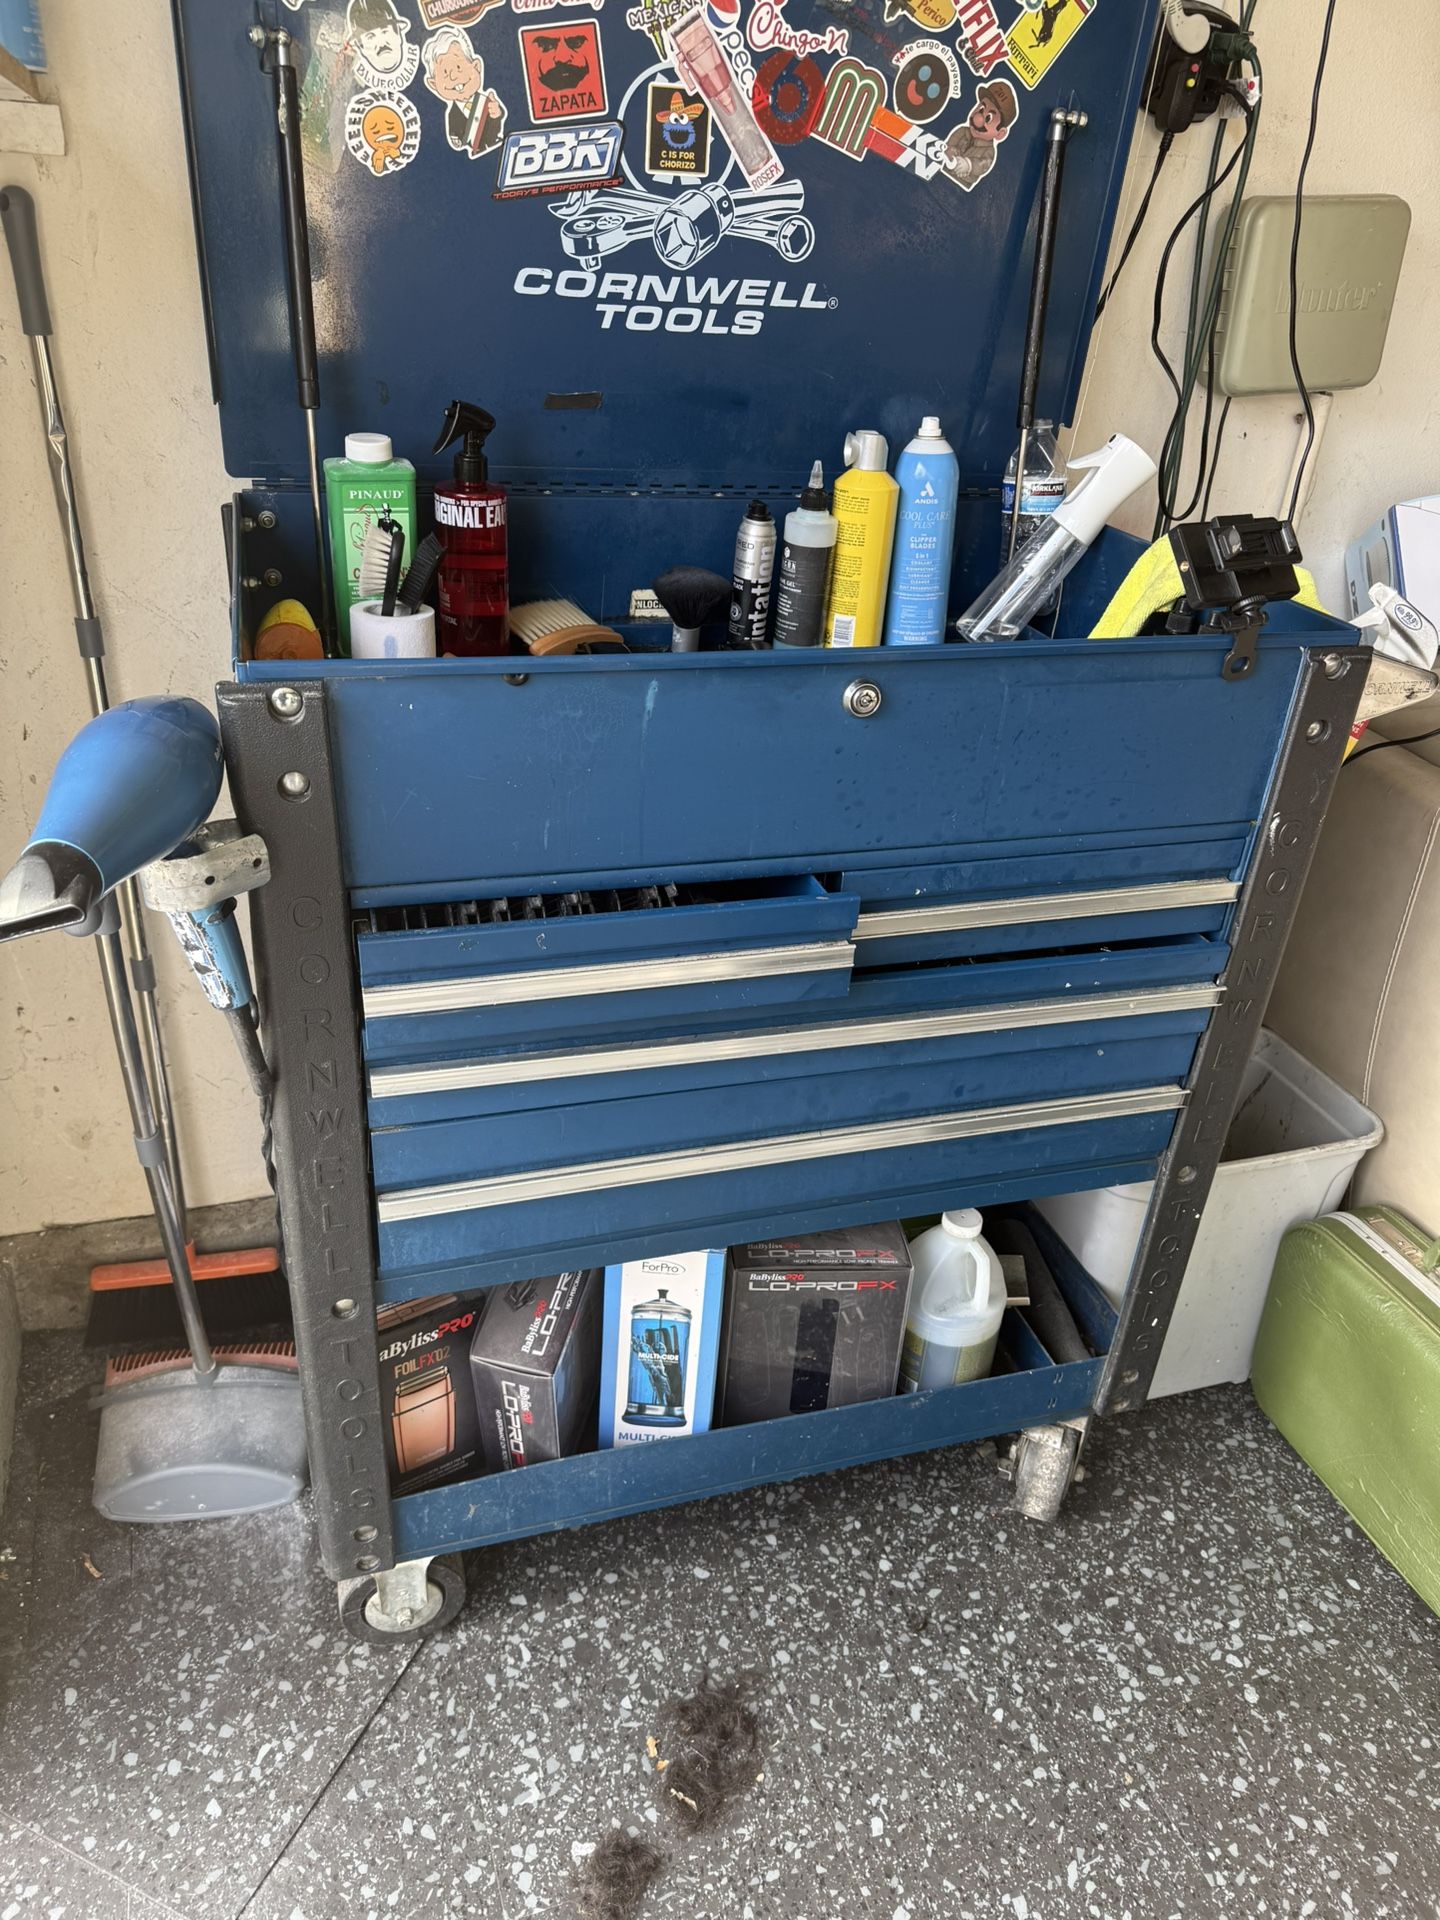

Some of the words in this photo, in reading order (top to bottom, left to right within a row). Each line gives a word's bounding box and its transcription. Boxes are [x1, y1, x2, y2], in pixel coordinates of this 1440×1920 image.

[915, 41, 935, 50] cargo
[941, 47, 949, 56] el
[540, 91, 597, 113] ZAPATA
[514, 128, 612, 176] BBK
[661, 151, 667, 159] C
[669, 151, 677, 159] IS
[679, 151, 695, 160] FOR
[659, 160, 696, 169] CHORIZO
[751, 162, 782, 190] ROSEFX
[513, 267, 828, 309] CORNWELL
[596, 304, 765, 335] TOOLS
[349, 490, 402, 499] PINAUD
[641, 1261, 679, 1274] ForPro
[750, 1273, 805, 1282] BaBylissPRO
[749, 1280, 897, 1292] LO-PROFX
[637, 1352, 679, 1361] MULTI-CIDE
